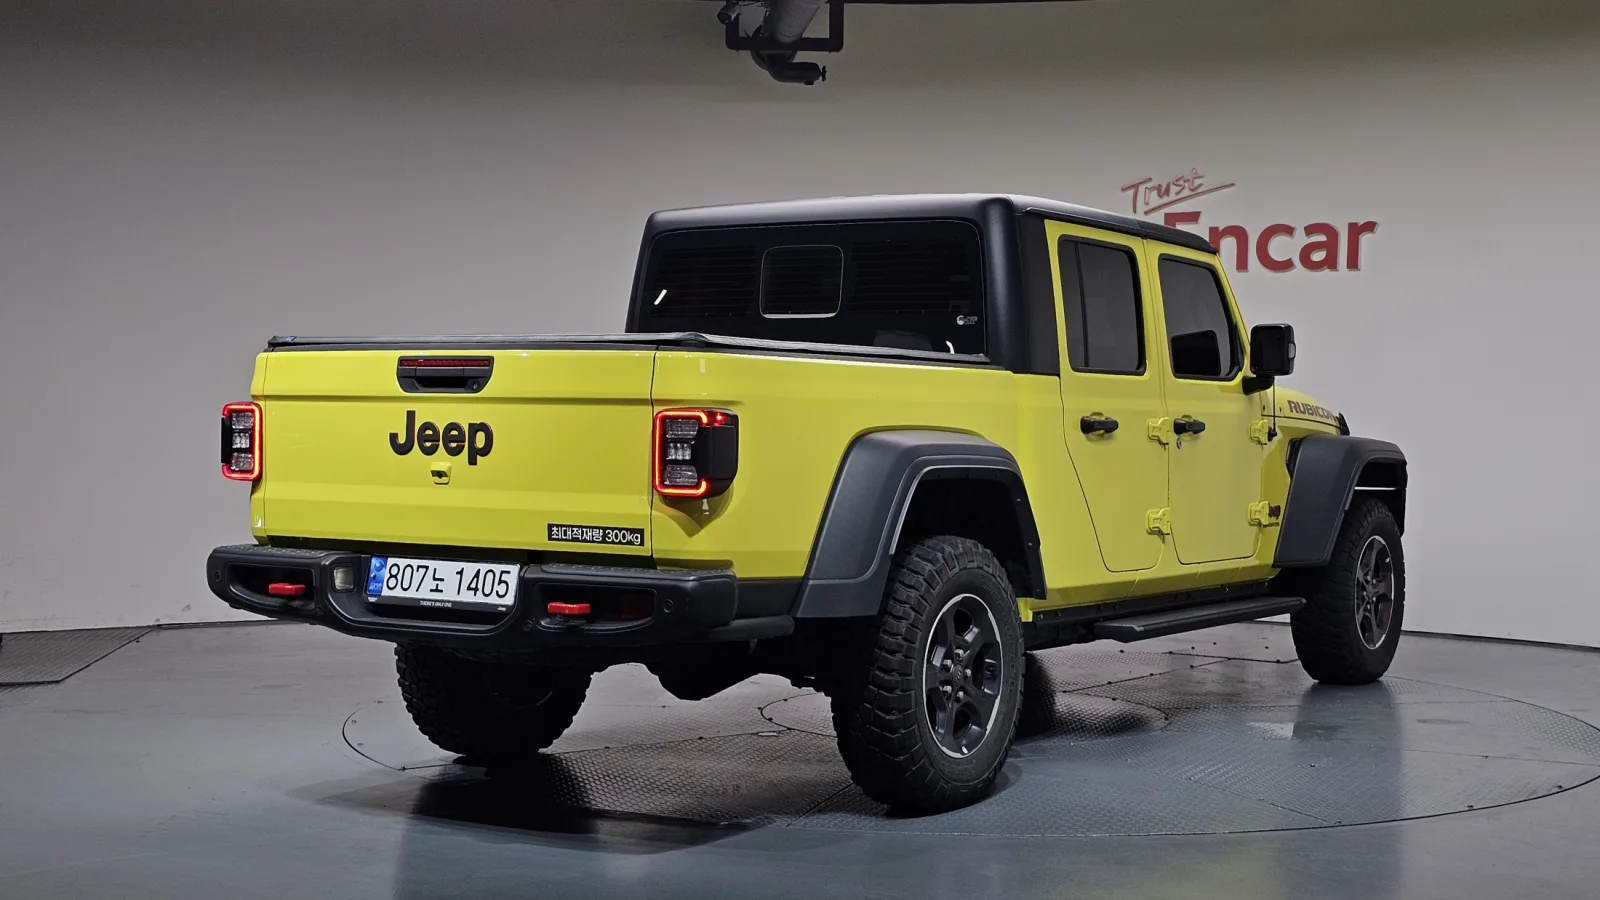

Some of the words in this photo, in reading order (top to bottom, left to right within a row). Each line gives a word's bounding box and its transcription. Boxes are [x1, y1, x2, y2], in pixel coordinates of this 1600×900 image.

[1121, 167, 1204, 214] Trust
[389, 410, 494, 466] Jeep
[551, 526, 604, 542] 최대적재량
[605, 529, 641, 545] 300kg
[386, 563, 445, 593] 807노
[456, 567, 511, 599] 1405
